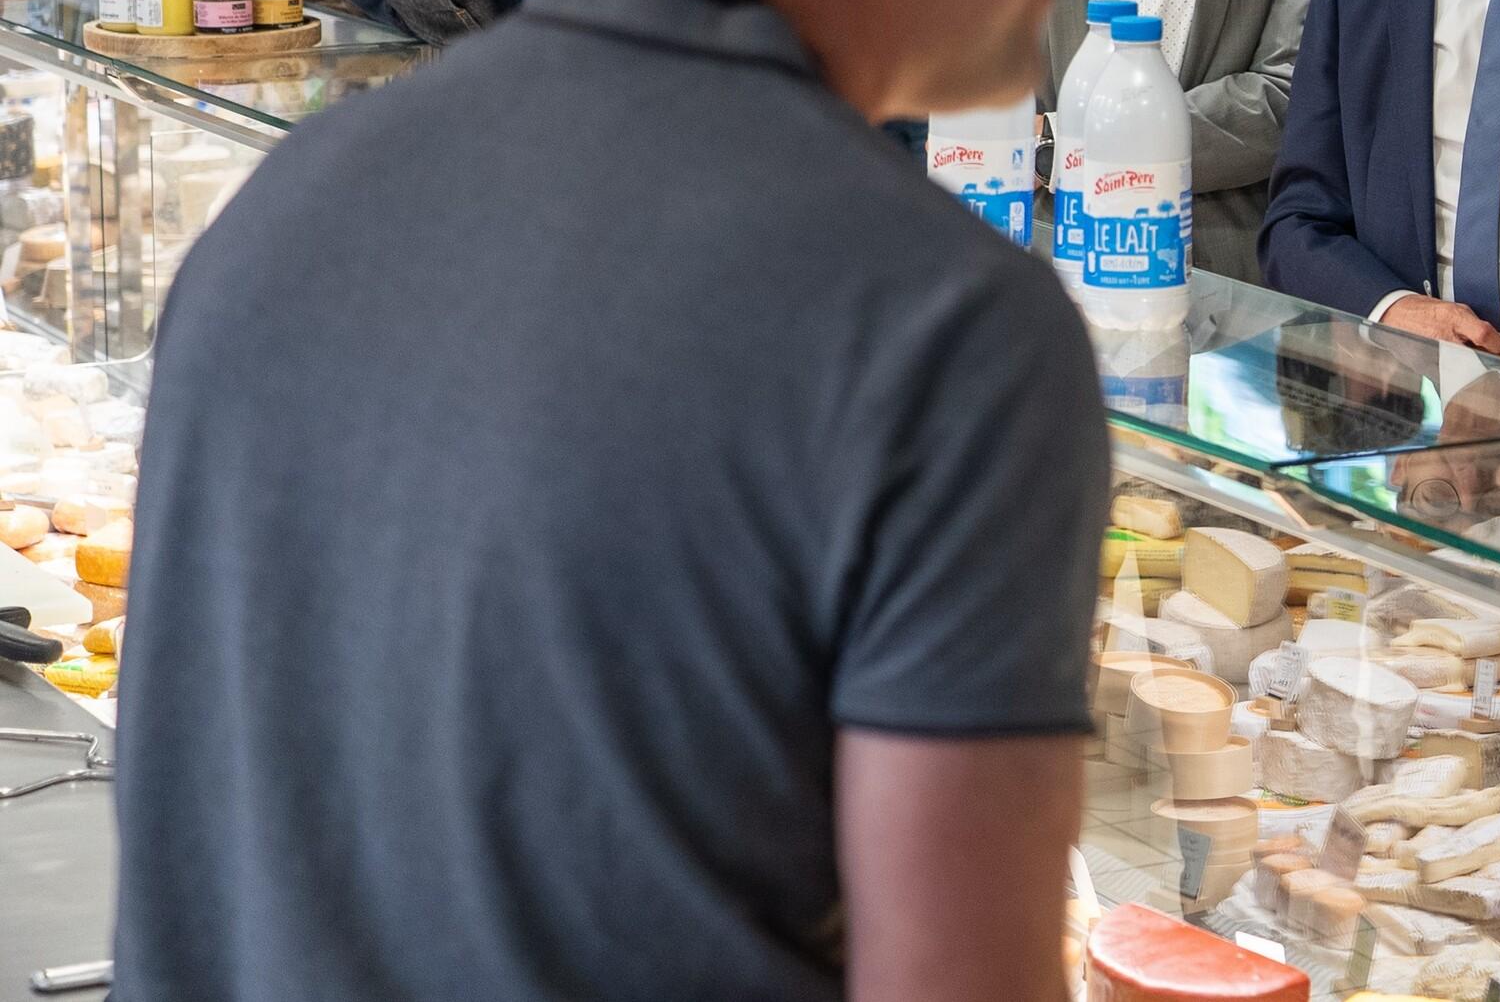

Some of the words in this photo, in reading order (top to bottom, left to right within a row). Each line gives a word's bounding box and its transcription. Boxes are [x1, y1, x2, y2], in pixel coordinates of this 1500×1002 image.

[1064, 196, 1078, 225] LE
[1094, 221, 1110, 252] LE
[1116, 221, 1159, 254] LAIT
